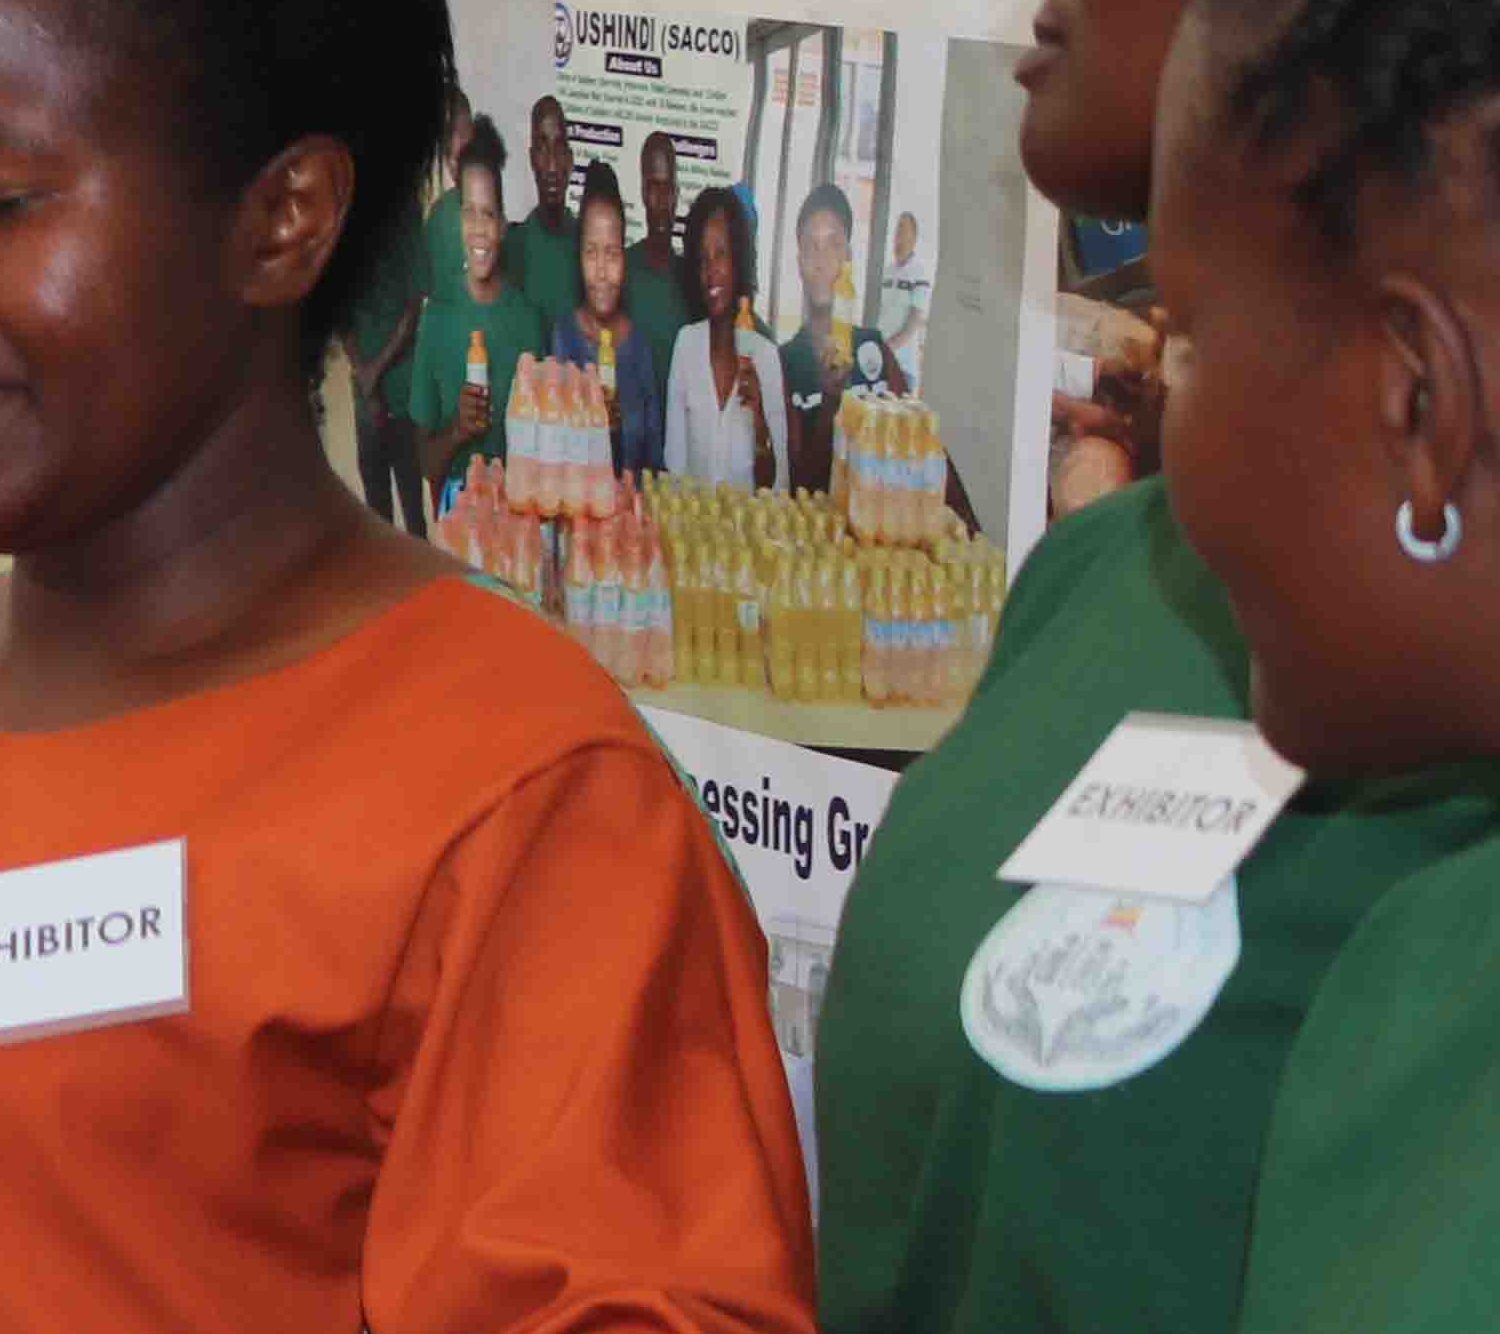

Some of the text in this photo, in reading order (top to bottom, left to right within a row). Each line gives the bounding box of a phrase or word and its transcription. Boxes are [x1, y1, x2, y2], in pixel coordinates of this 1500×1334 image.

[576, 10, 741, 63] USHINDI (SACCO)
[692, 776, 813, 880] essing
[1067, 783, 1257, 835] EXHIBITOR
